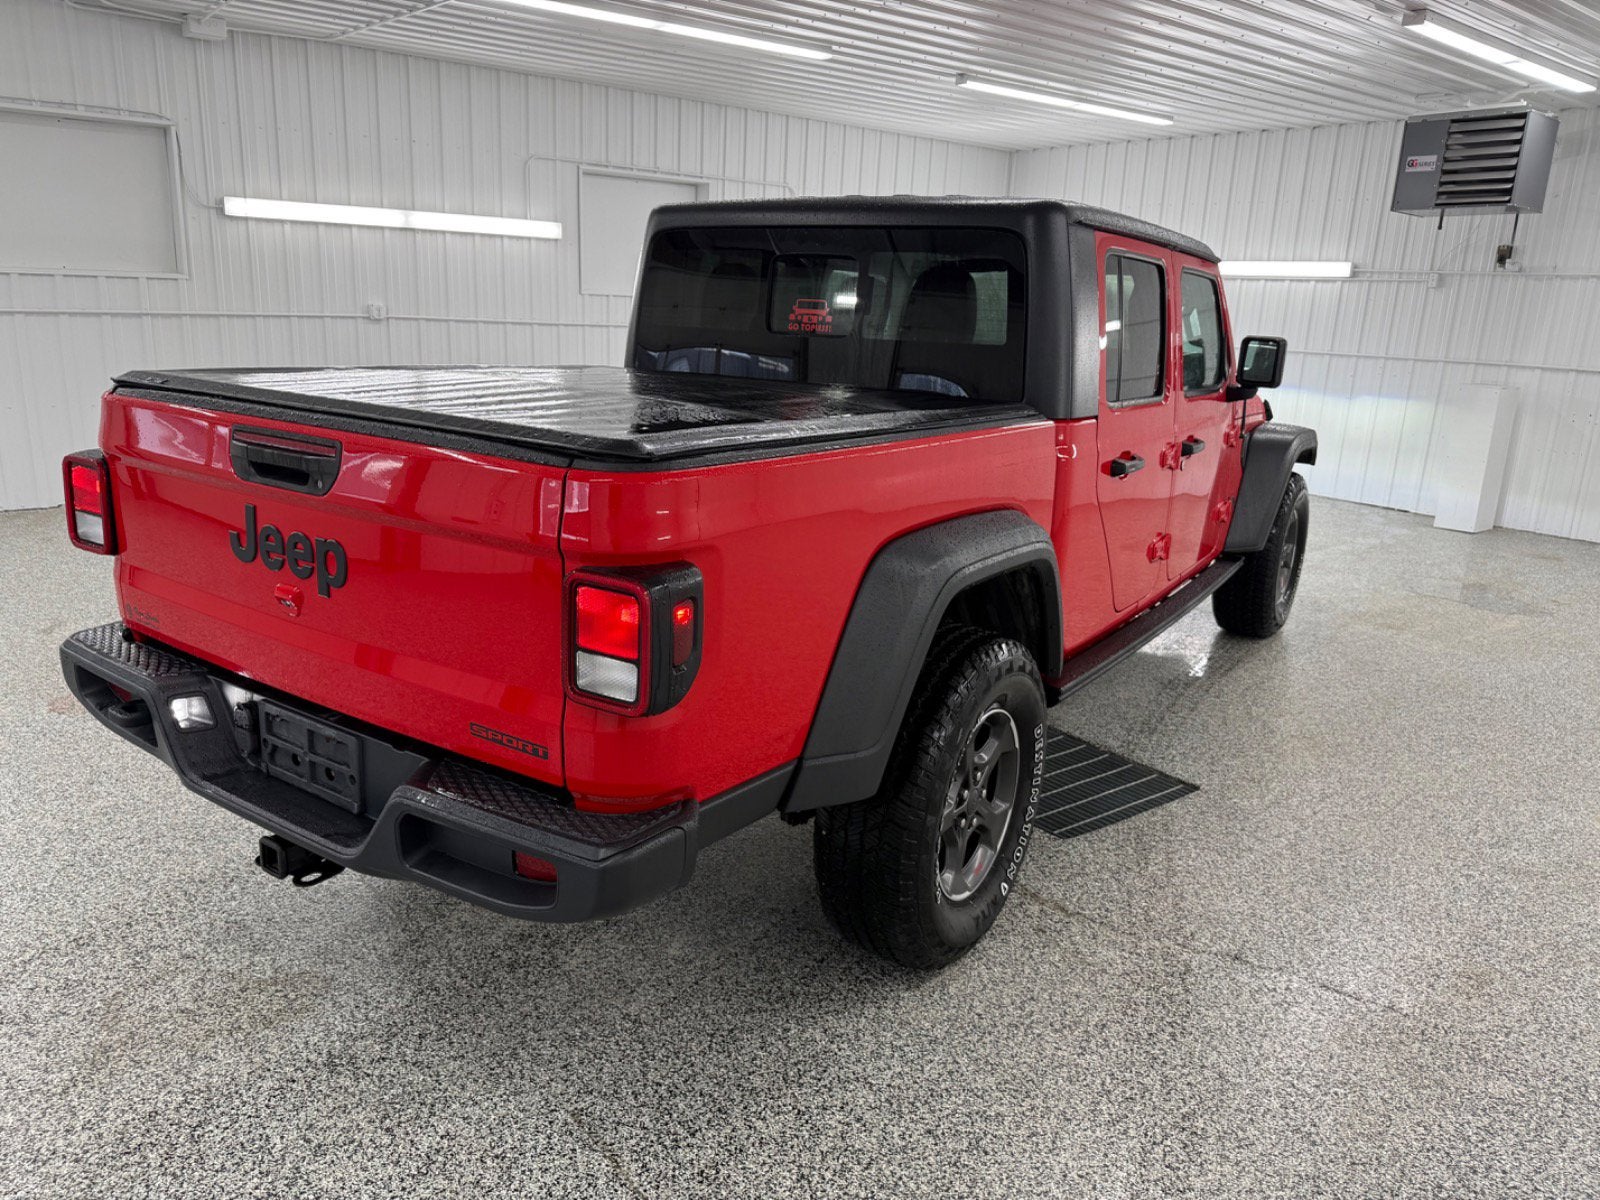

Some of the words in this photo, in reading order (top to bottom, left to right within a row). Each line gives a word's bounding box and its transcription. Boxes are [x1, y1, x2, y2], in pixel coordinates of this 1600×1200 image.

[229, 503, 347, 599] Jeep
[470, 723, 548, 759] SPORT
[1006, 723, 1044, 881] DESTINATION
